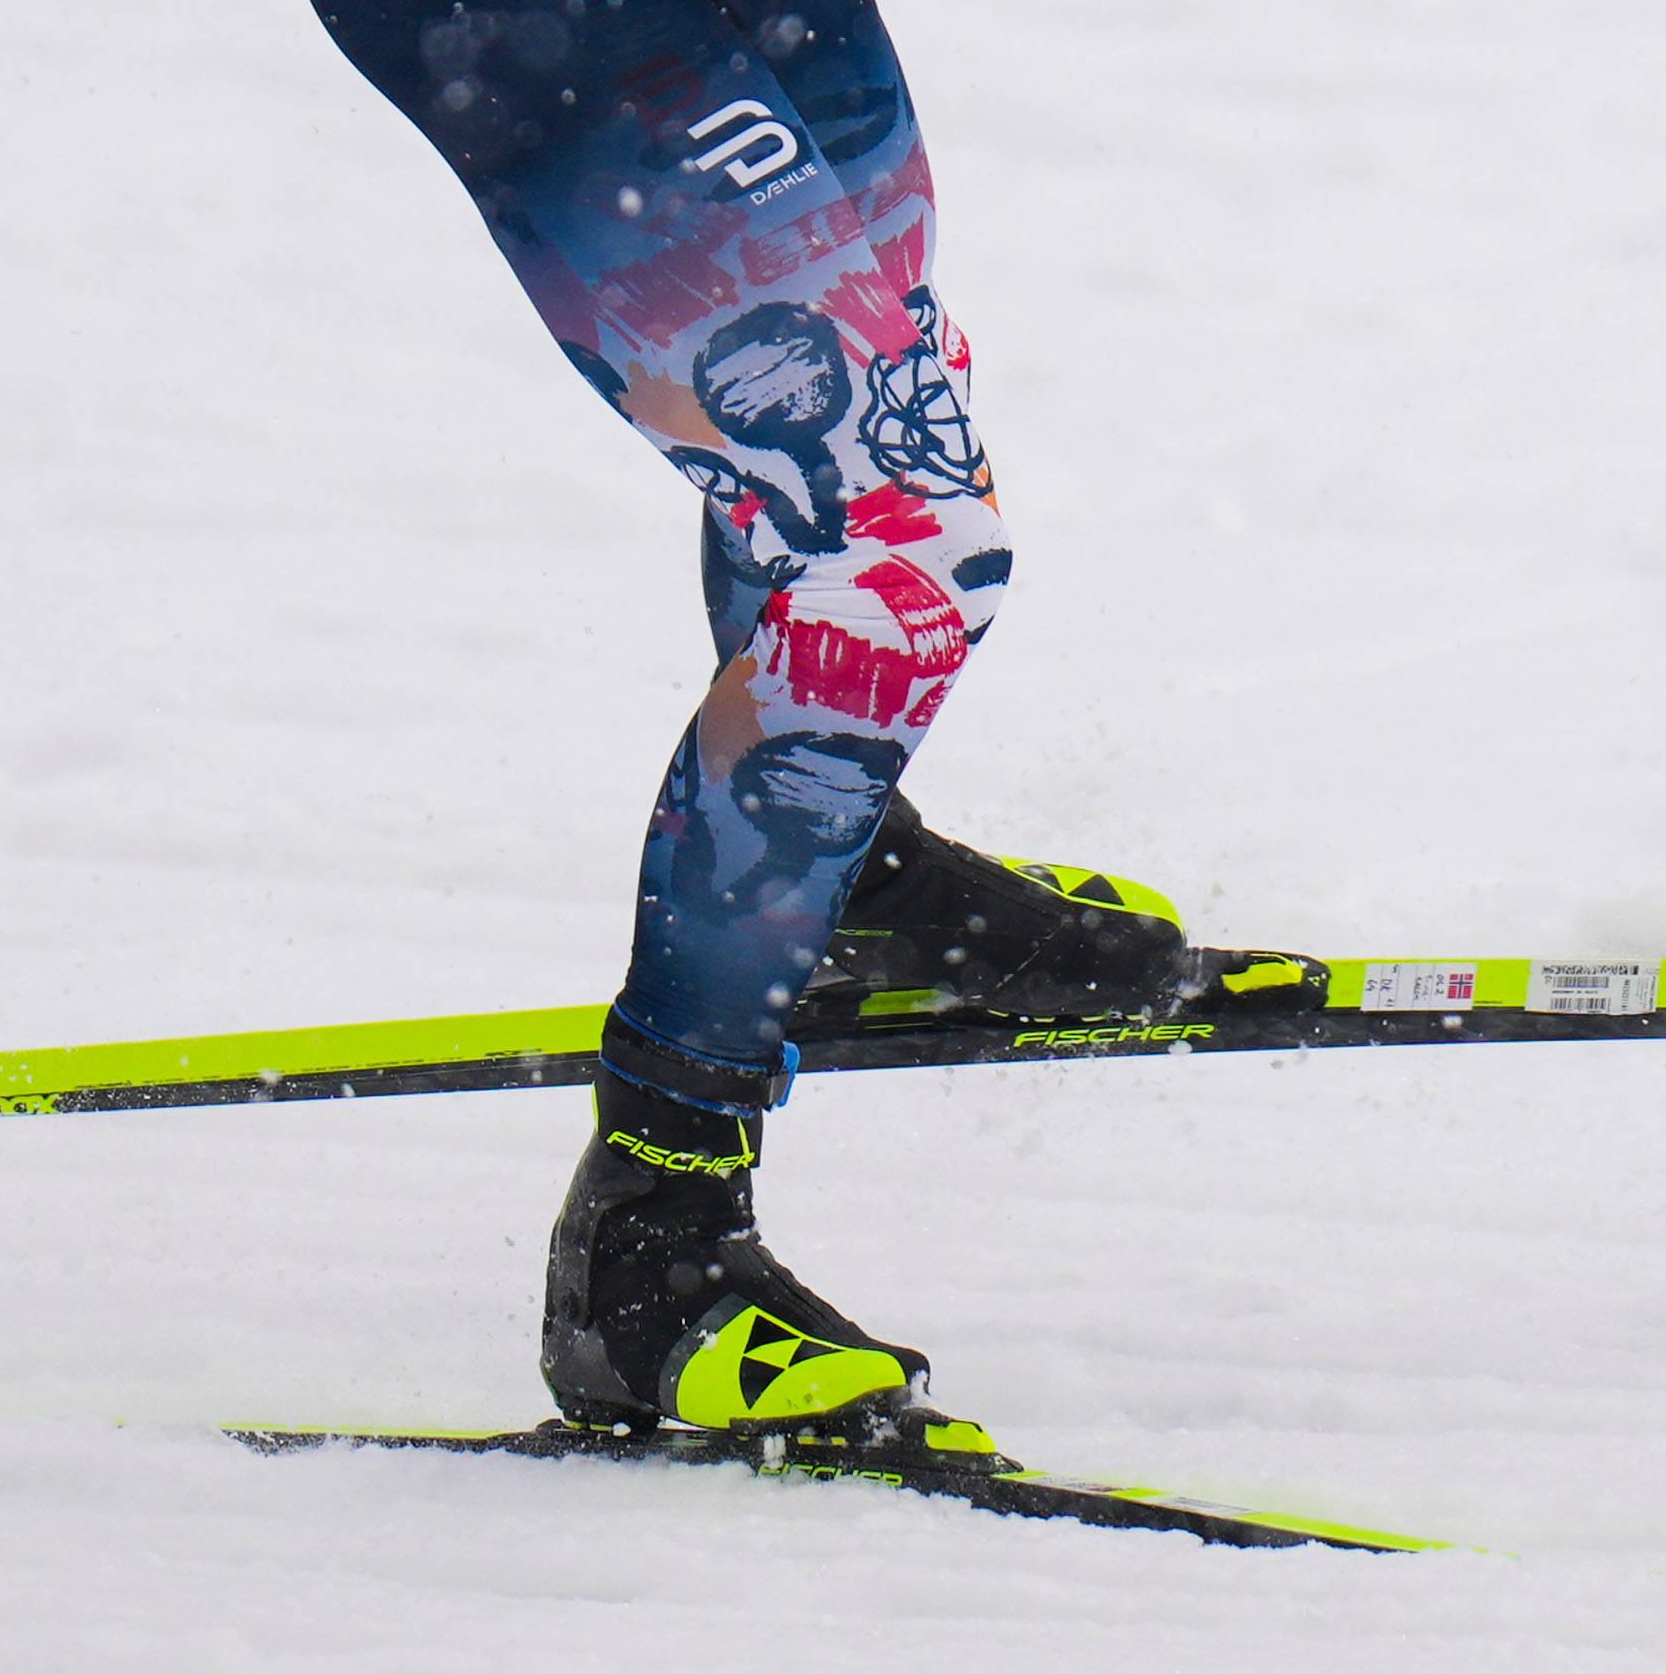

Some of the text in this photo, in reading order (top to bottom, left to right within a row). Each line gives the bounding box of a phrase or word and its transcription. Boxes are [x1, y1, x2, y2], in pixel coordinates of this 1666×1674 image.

[750, 162, 818, 206] DÆHLIE
[1013, 1023, 1215, 1047] FISCHER
[606, 1130, 756, 1176] FISCHER
